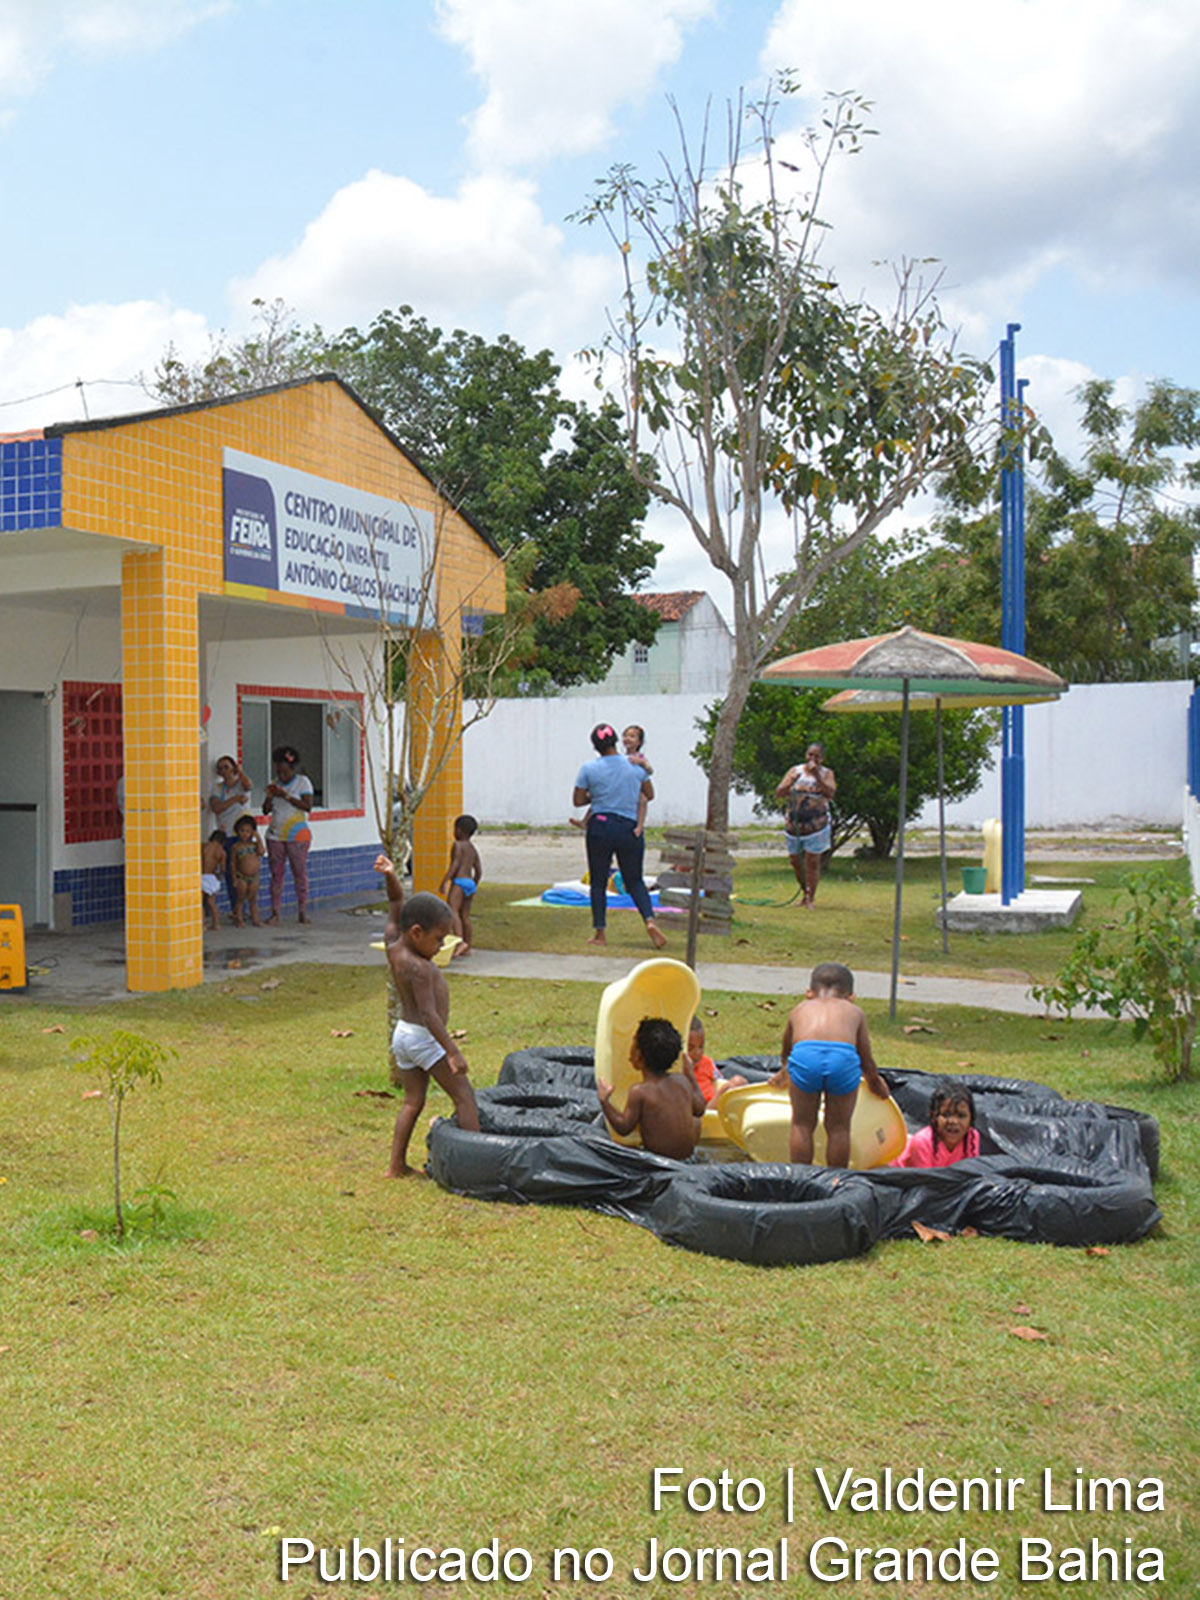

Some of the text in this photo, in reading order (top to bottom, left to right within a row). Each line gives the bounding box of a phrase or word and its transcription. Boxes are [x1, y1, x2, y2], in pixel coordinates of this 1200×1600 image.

[230, 514, 271, 550] FEIRA
[284, 490, 417, 549] CENTRO MUNICIPAL DE
[285, 527, 344, 562] EDUCAÇÃO
[346, 542, 389, 572] INFATIL
[285, 560, 337, 591] ANTÔNIO
[339, 572, 377, 599] CARLOS
